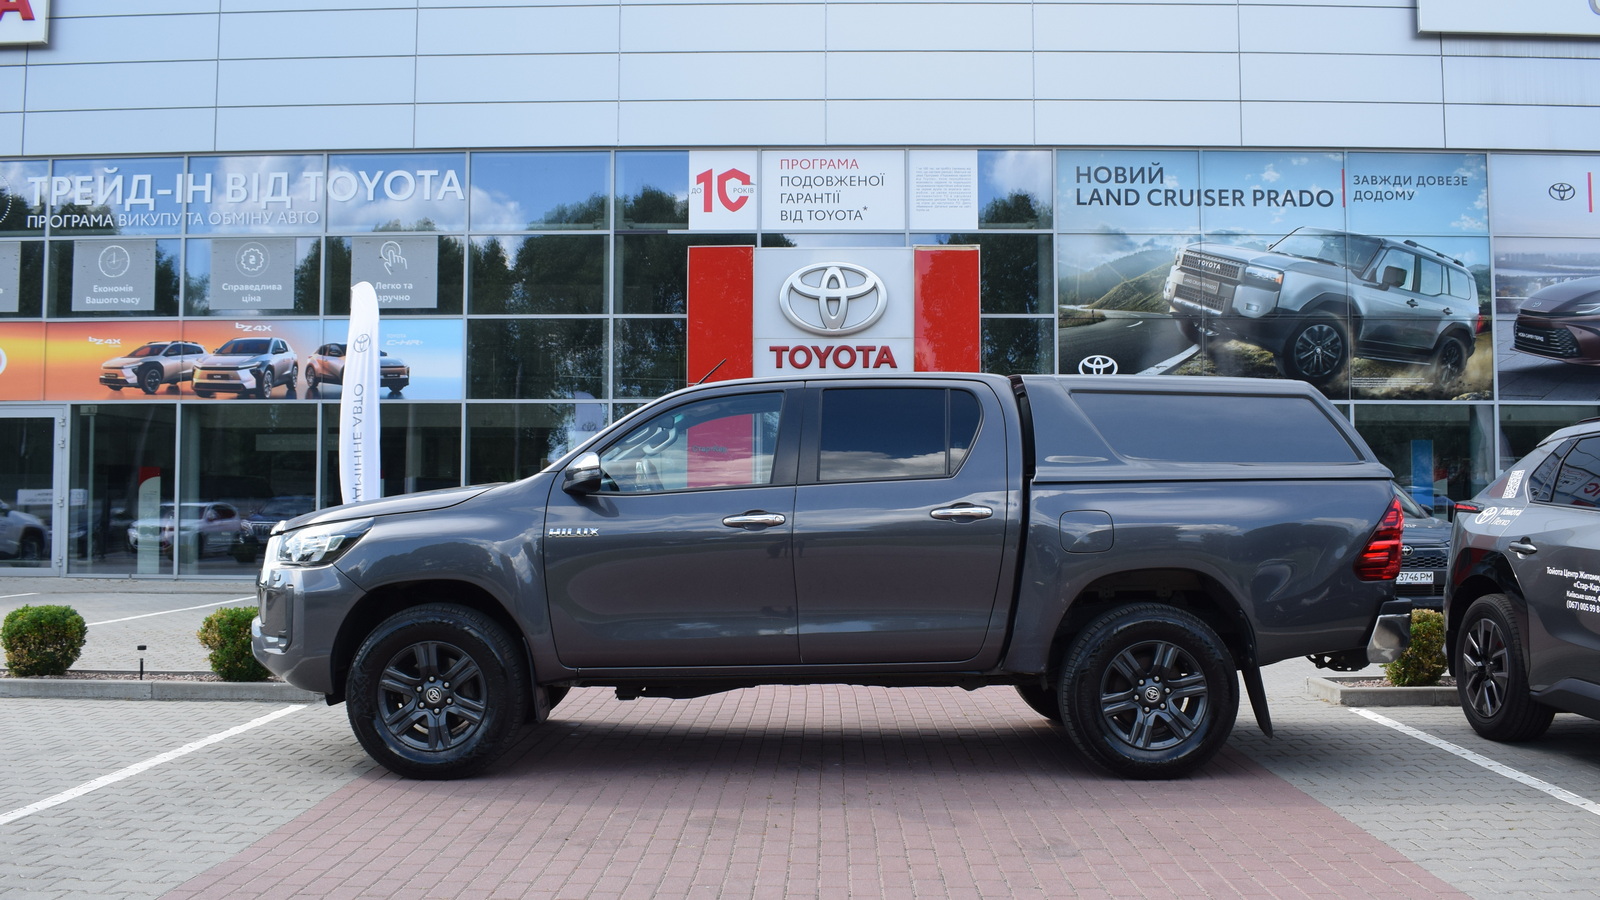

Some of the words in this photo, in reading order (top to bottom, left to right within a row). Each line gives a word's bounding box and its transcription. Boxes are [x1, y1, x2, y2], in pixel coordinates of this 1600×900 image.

[780, 159, 860, 170] ПРОГРАМА
[1076, 162, 1164, 185] НОВИЙ
[780, 172, 886, 189] ПОДОВЖЕНОЇ
[1353, 175, 1412, 187] ЗАВЖДИ
[1416, 176, 1468, 188] ДОВЕЗЕ
[27, 167, 212, 211] ТРЕЙД-ІН
[226, 171, 292, 210] ВІД
[302, 169, 465, 202] TOYOTA
[780, 190, 841, 204] ГАРАНТІЇ
[1076, 188, 1140, 206] LAND
[1147, 188, 1245, 207] CRUISER
[1252, 189, 1334, 207] PRADO
[1353, 190, 1415, 202] ДОДОМУ
[27, 213, 114, 229] ПРОГРАМА
[118, 212, 182, 227] ВИКУПУ
[186, 212, 204, 226] ТА
[208, 210, 272, 226] ОБМІНУ
[277, 210, 319, 225] АВТО
[780, 210, 803, 223] ВІД
[1197, 259, 1221, 270] TOYOTA
[93, 283, 134, 293] Економія
[221, 282, 282, 293] Справедлива
[375, 281, 401, 290] Легко
[85, 296, 119, 304] Вашого
[120, 297, 140, 305] часу
[241, 294, 262, 303] ціна
[377, 294, 411, 303] зручно
[769, 345, 898, 369] TOYOTA
[548, 528, 600, 538] HILUX
[1399, 572, 1419, 582] 3746
[1420, 572, 1433, 582] PM
[1546, 566, 1564, 576] Тойота
[1563, 568, 1579, 580] Центр
[1579, 571, 1600, 583] Житоми
[1566, 599, 1580, 611] (067)
